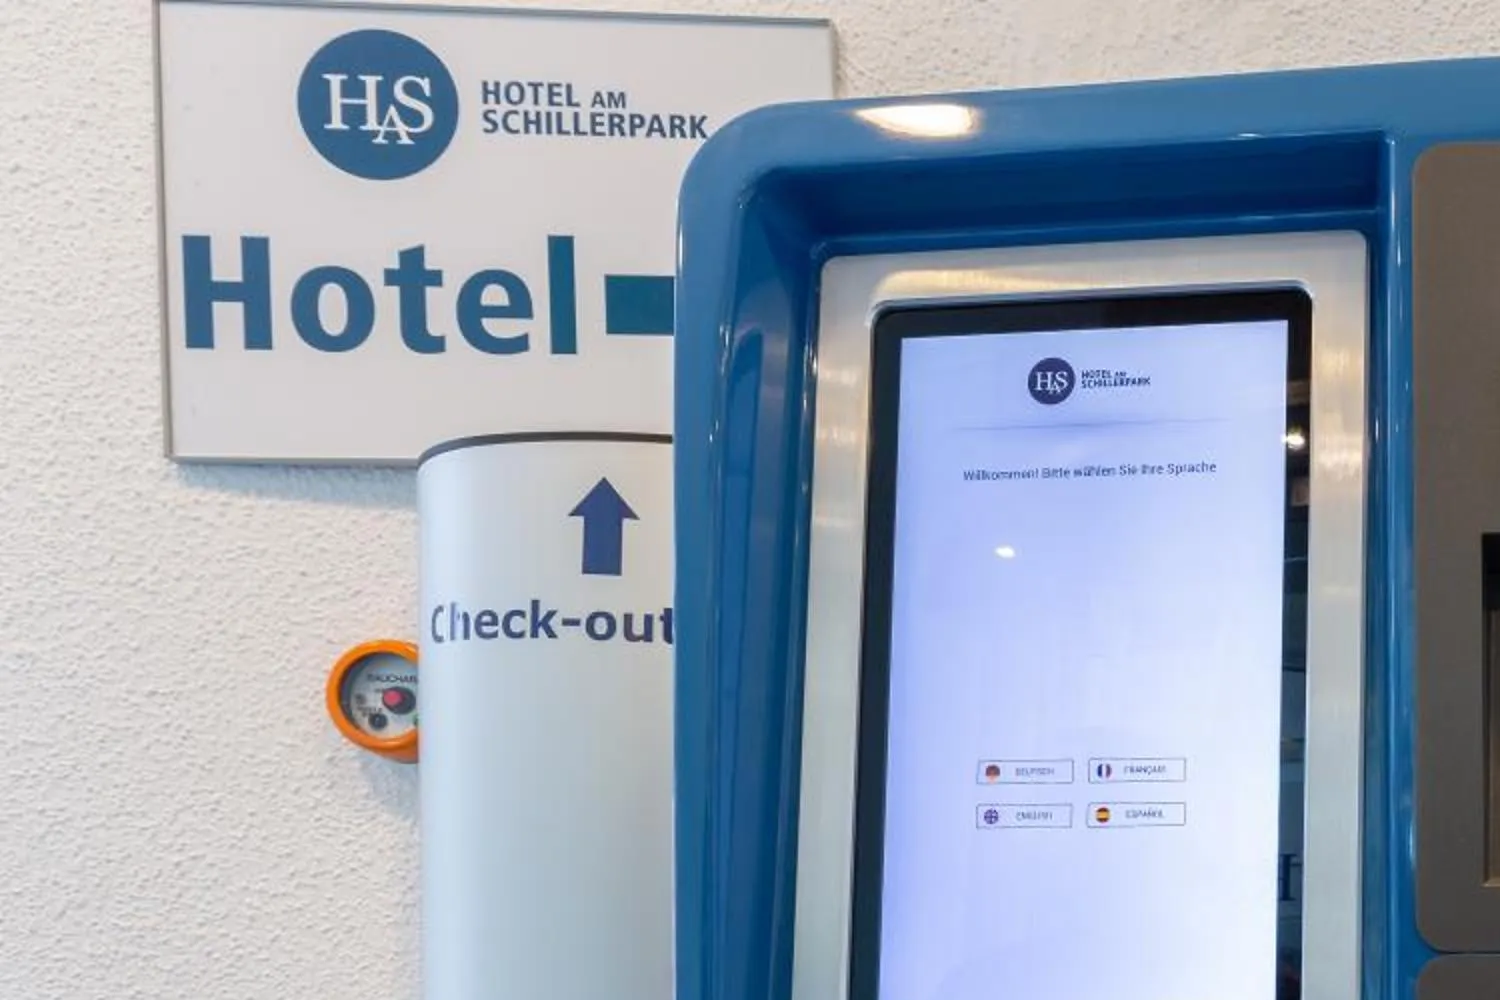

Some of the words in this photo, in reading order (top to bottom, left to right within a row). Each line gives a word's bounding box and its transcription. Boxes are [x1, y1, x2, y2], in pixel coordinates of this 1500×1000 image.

[481, 80, 581, 108] HOTEL
[591, 90, 627, 109] AM
[481, 109, 708, 139] SCHILLERPARK
[1081, 369, 1112, 379] HOTEL
[1042, 467, 1071, 480] Bitte
[1073, 465, 1117, 479] wählen
[1119, 464, 1137, 476] Sie
[1141, 463, 1164, 475] Ihre
[1166, 460, 1217, 477] Sprache
